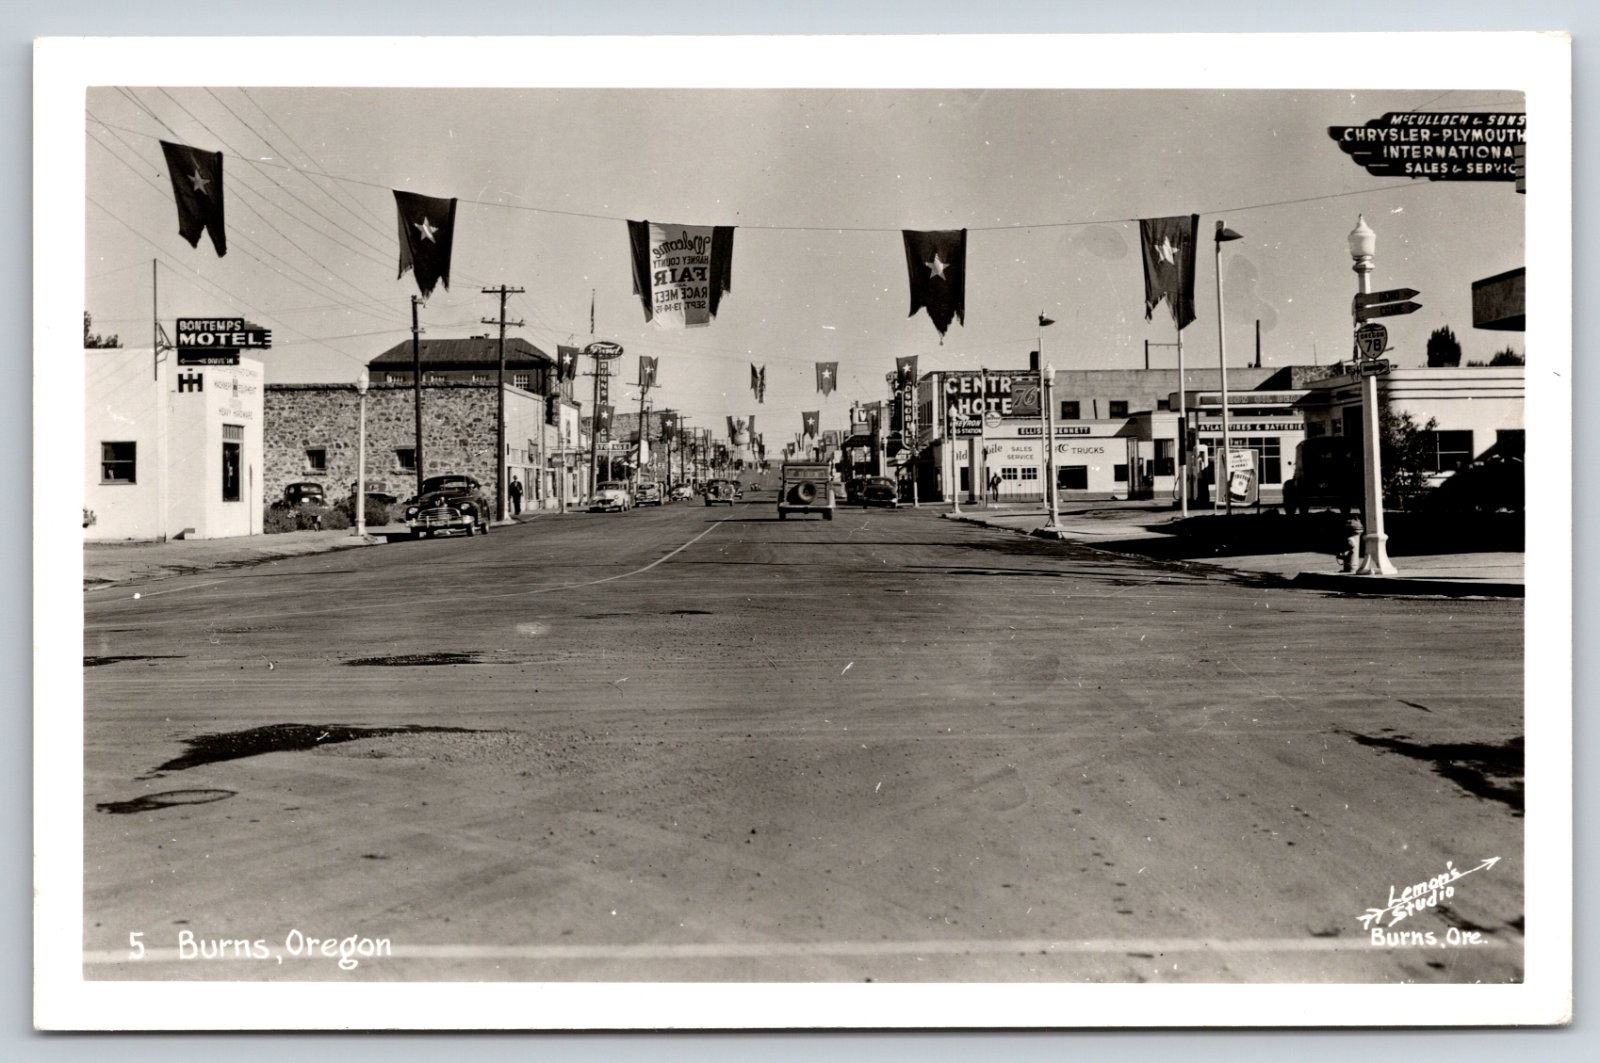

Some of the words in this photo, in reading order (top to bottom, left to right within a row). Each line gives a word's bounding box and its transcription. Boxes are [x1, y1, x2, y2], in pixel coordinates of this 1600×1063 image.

[1486, 115, 1526, 125] SONS
[1343, 128, 1526, 142] CHRYSLER-PLYMOUTH
[1383, 145, 1514, 159] INTERNATIONA
[1405, 163, 1448, 174] SALES
[1466, 163, 1517, 174] SERVIC
[180, 320, 242, 331] BONTEMPS
[179, 332, 262, 346] MOTEL
[1360, 331, 1385, 339] OREGON
[1364, 339, 1382, 353] 78
[945, 376, 1012, 394] CENTR
[1012, 385, 1037, 408] 76
[958, 398, 1013, 415] HOTE
[1020, 427, 1043, 436] ELLIS
[1228, 424, 1252, 432] TIRES
[1071, 446, 1105, 455] TRUCKS
[1006, 453, 1035, 461] SERVICE
